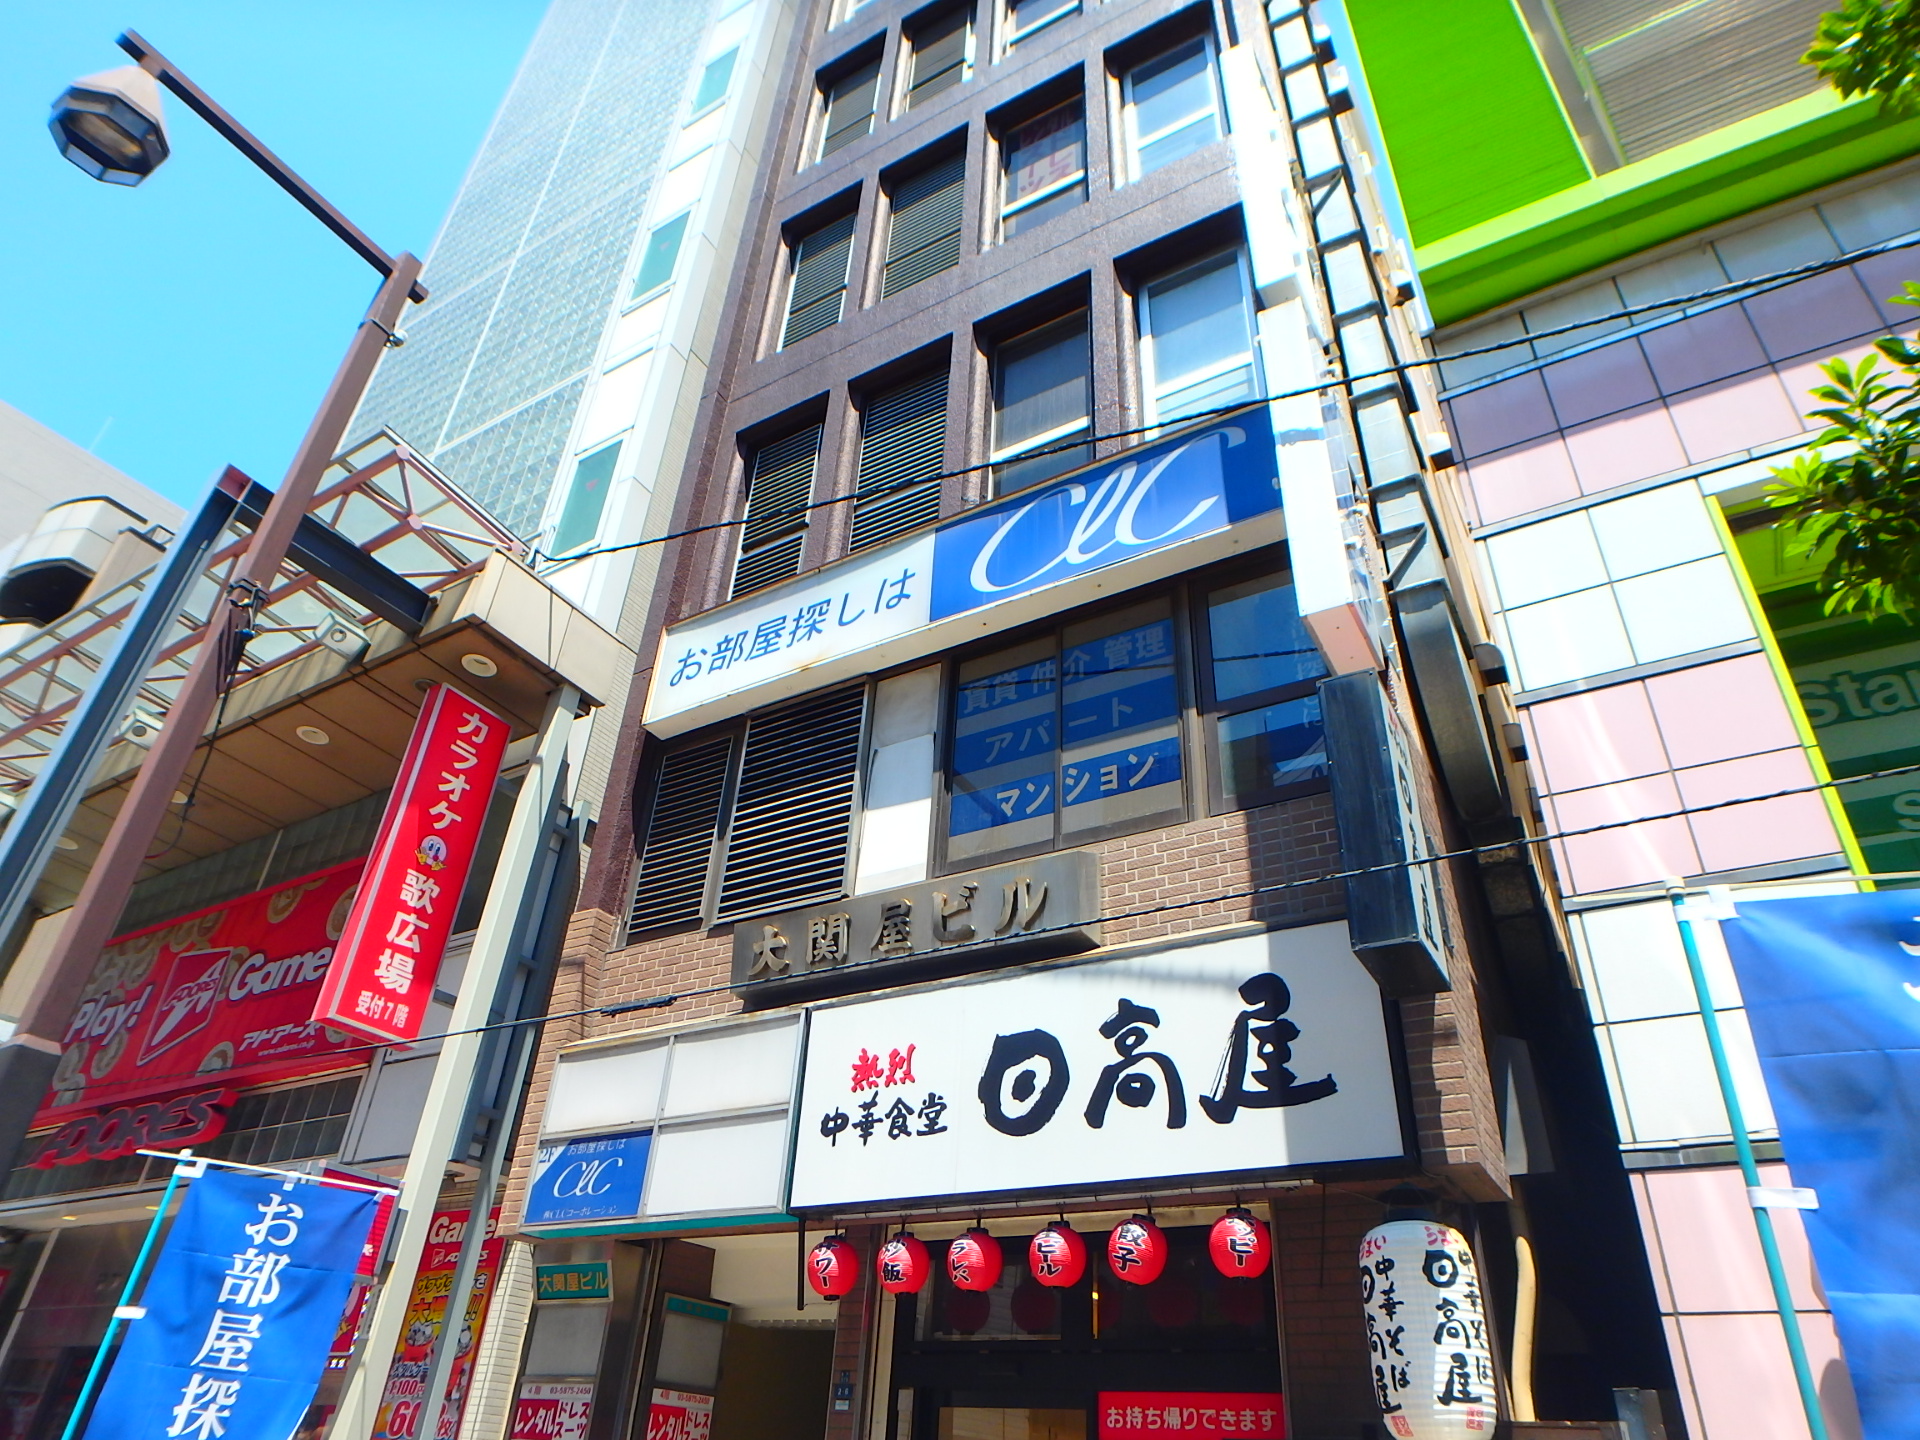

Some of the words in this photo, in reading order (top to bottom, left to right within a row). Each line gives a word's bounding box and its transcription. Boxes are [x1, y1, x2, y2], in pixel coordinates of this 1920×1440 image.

[669, 568, 916, 688] お部屋探しは
[963, 671, 1018, 715] 賃貸
[1031, 650, 1091, 694] 仲介
[1104, 625, 1166, 670] 管理
[985, 697, 1133, 763] アパート
[428, 711, 490, 831] カラオケ
[996, 752, 1157, 817] マンション
[374, 868, 441, 996] 歌広場
[747, 878, 1049, 977] 大関屋ビル
[63, 985, 154, 1046] Play!
[850, 1043, 917, 1093] 熱烈
[978, 972, 1340, 1137] 日高屋
[567, 1138, 627, 1156] お部屋探しは
[819, 1091, 949, 1147] 中華食堂
[1112, 1221, 1149, 1274] 餃子
[539, 1271, 609, 1293] 大関屋ビル
[1375, 1255, 1412, 1392] 中華そば
[1422, 1249, 1483, 1406] 日高屋
[513, 1405, 557, 1435] レンタル
[558, 1401, 590, 1420] ドレス
[686, 1410, 710, 1428] ドレス
[1106, 1406, 1277, 1432] お持ち帰りできます
